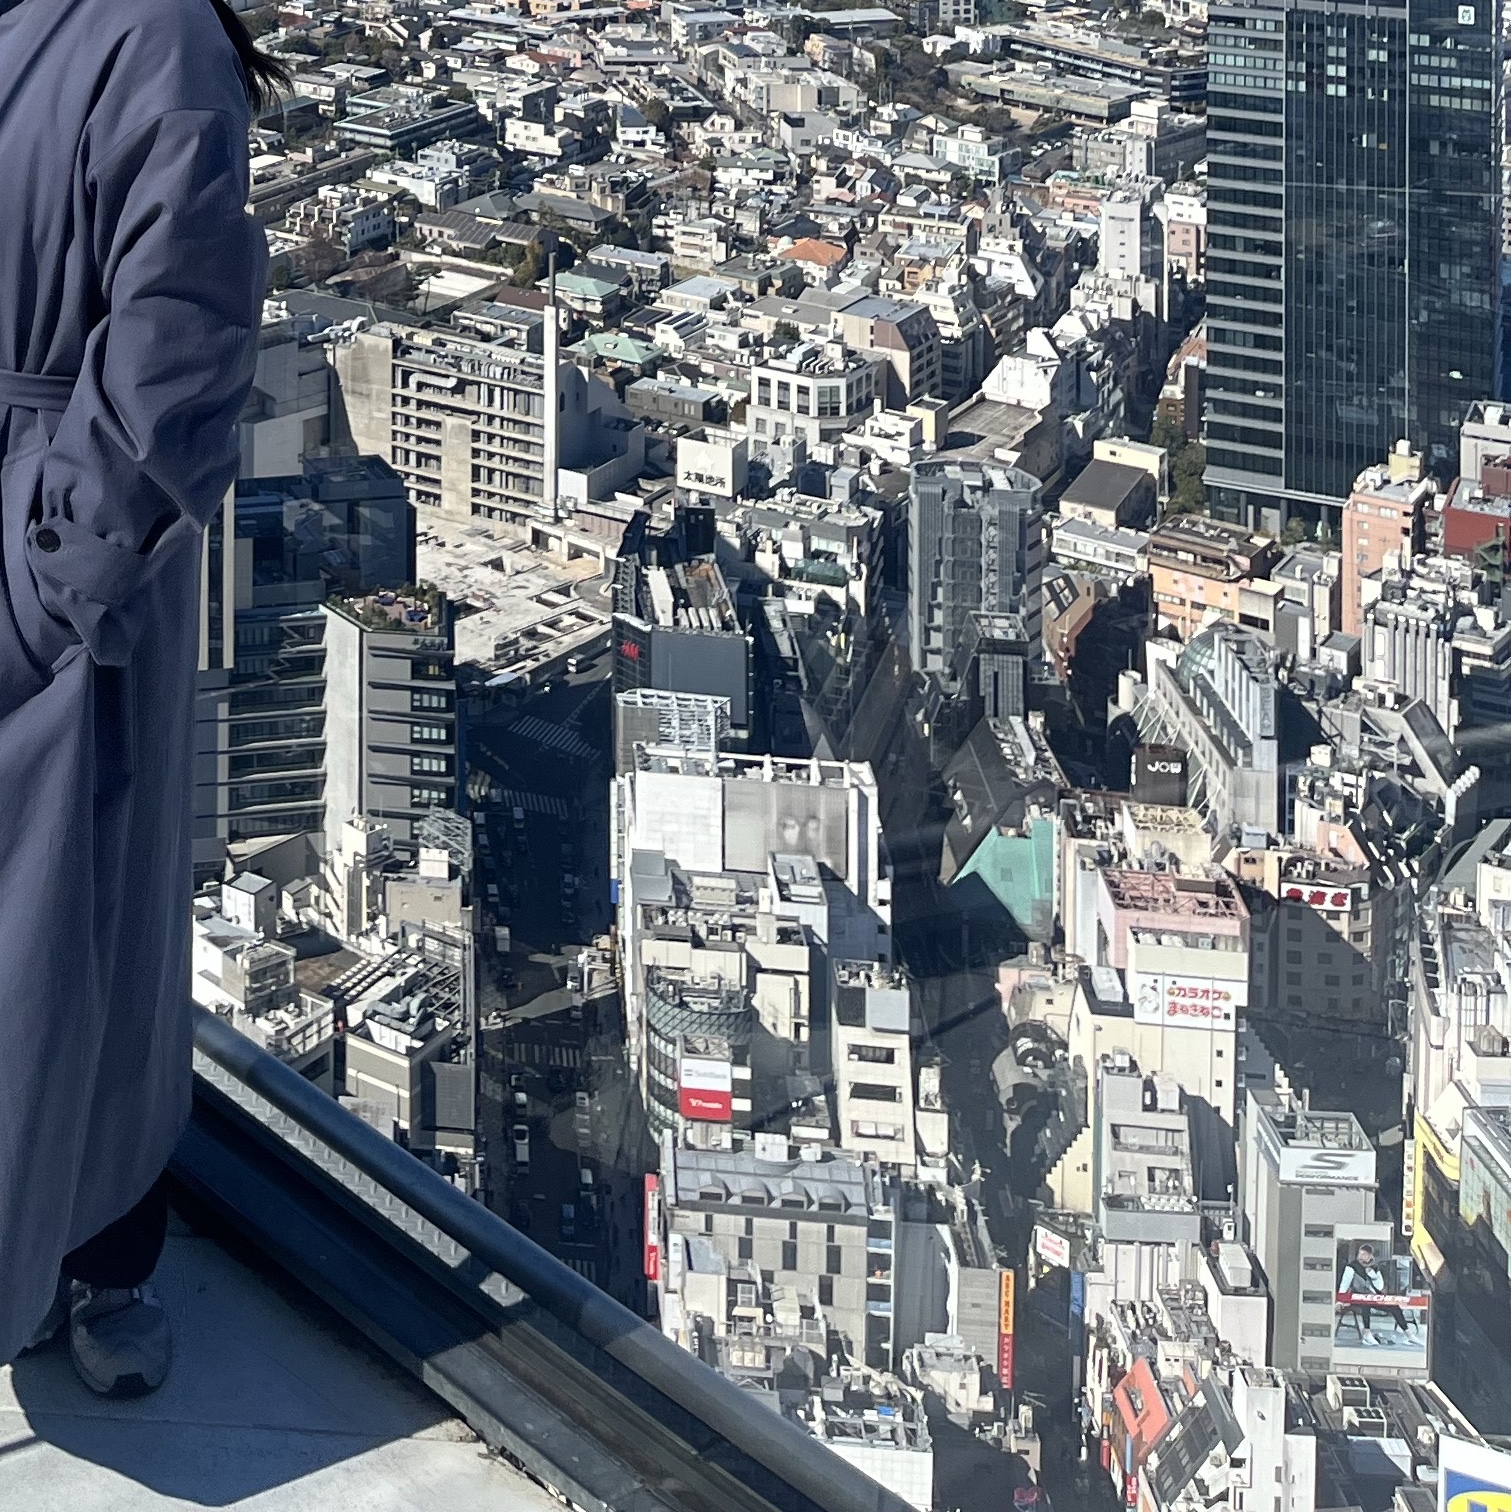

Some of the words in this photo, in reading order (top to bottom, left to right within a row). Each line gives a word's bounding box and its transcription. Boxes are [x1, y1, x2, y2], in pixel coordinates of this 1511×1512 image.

[683, 471, 726, 488] 太陽地所
[1174, 986, 1223, 1001] カラオケ
